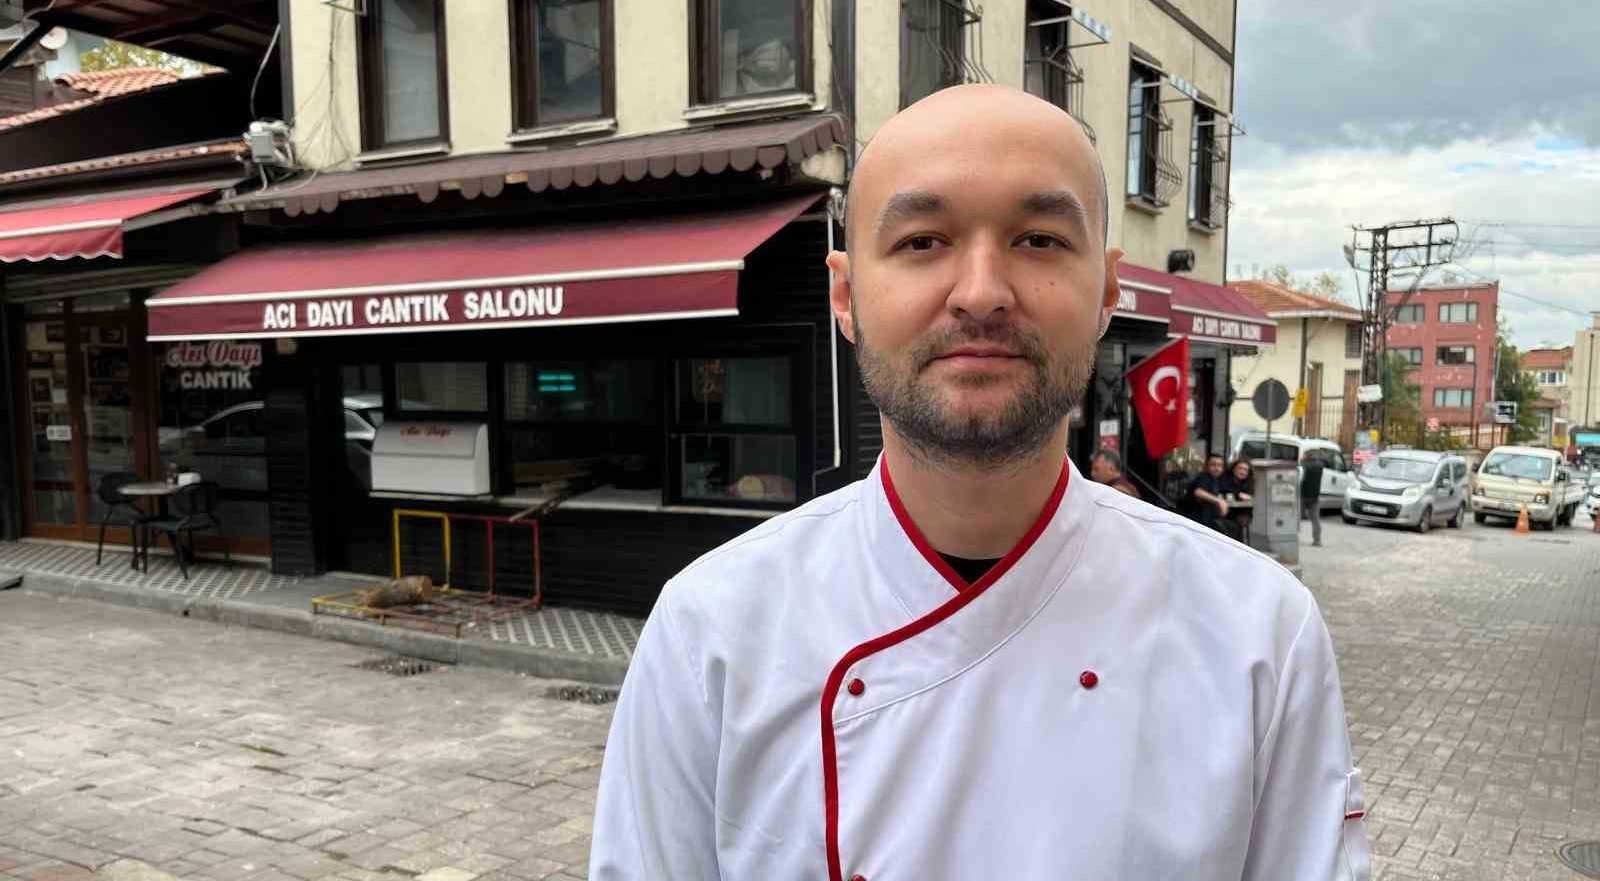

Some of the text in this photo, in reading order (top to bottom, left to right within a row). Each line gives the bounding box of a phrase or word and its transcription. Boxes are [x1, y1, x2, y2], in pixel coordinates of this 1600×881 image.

[263, 286, 564, 330] ACI DAYI CANTIK SALONU
[181, 371, 252, 390] CANTIK
